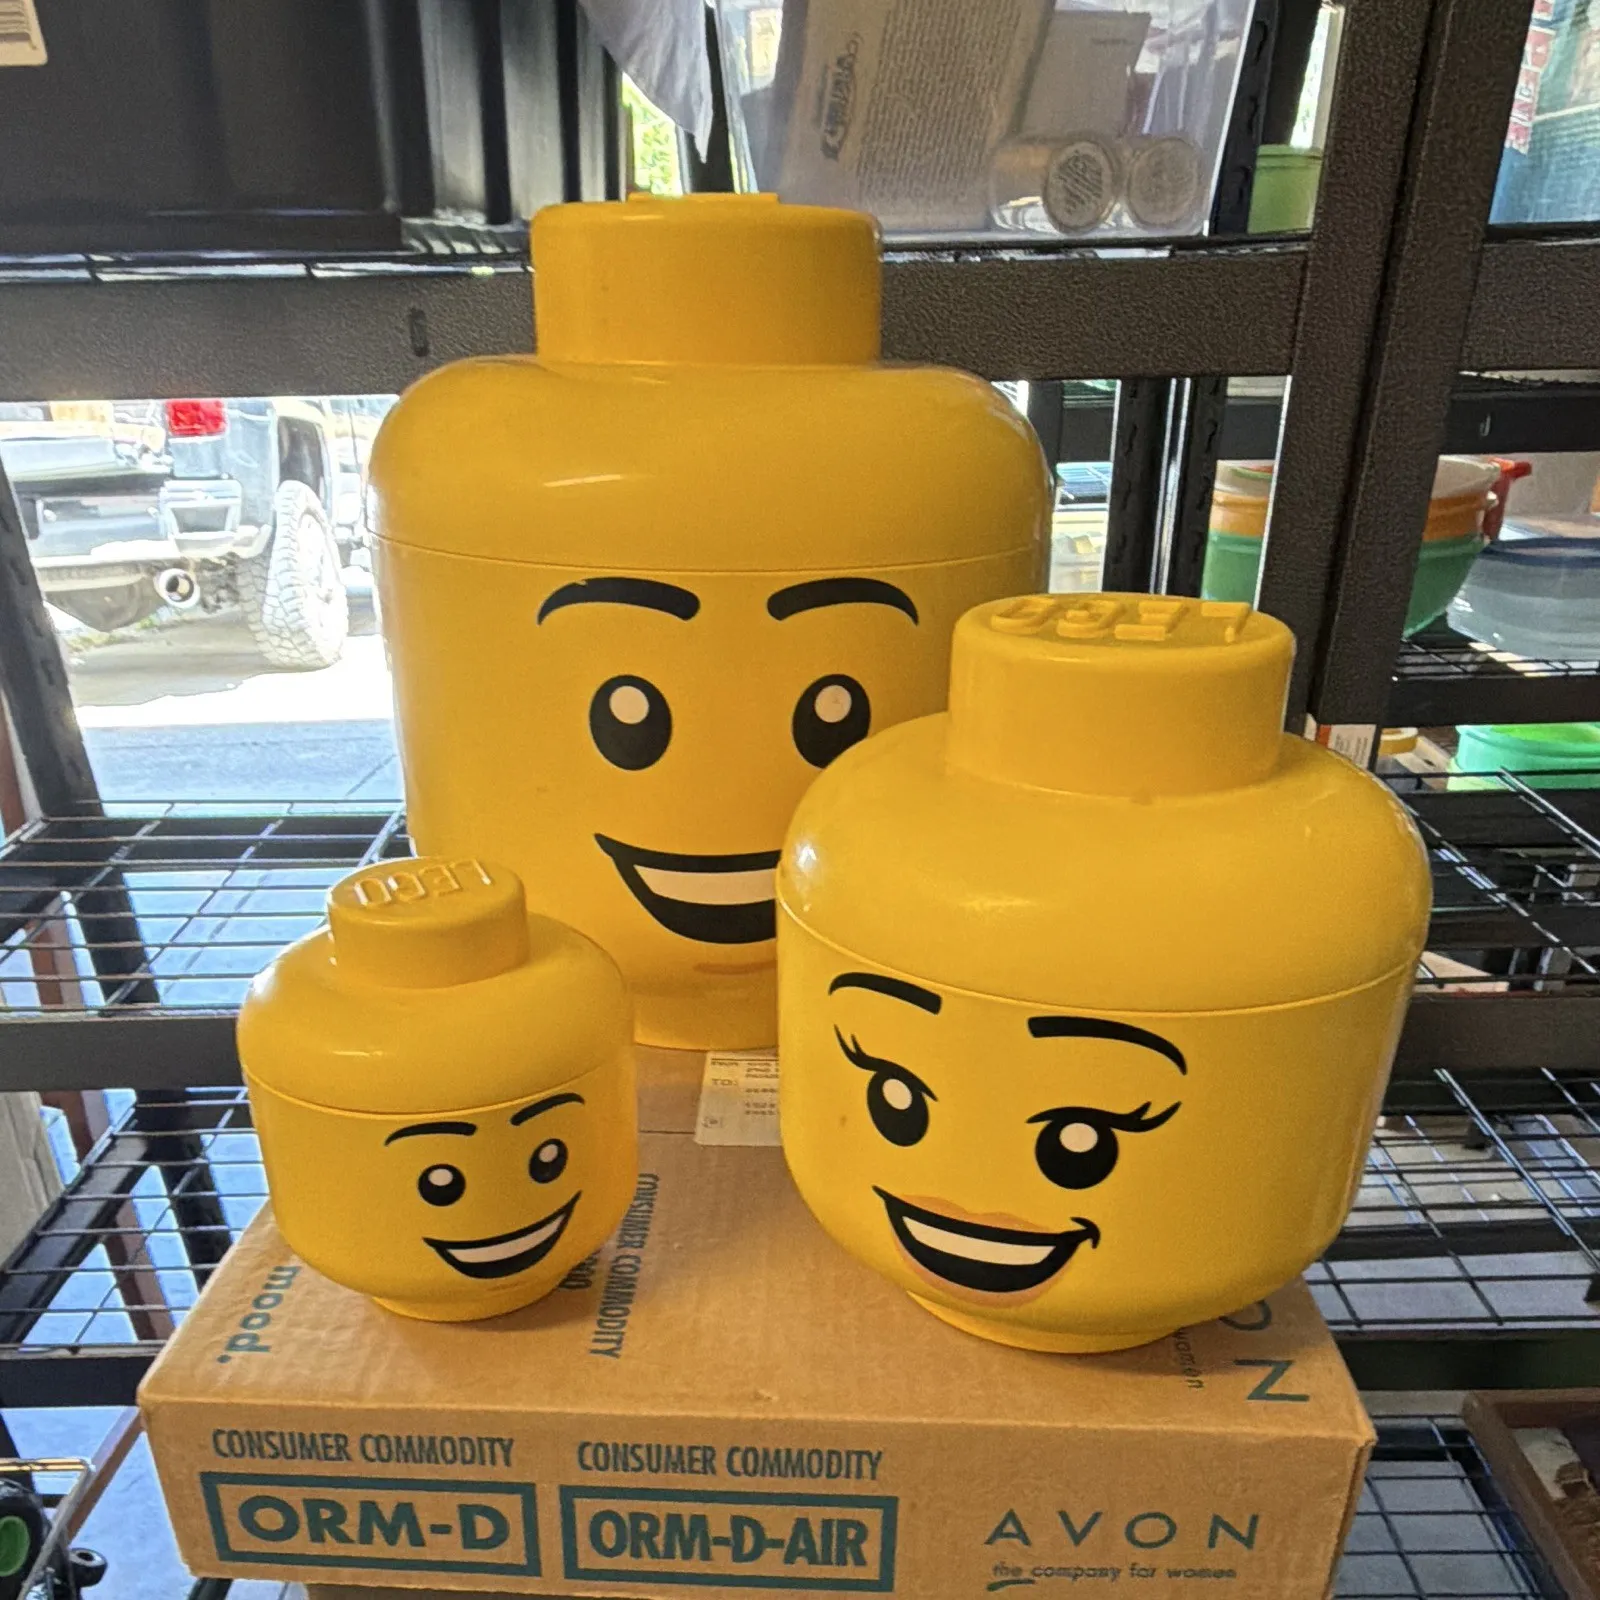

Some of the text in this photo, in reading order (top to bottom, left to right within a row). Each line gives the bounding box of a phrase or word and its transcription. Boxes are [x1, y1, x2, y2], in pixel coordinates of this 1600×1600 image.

[988, 597, 1251, 644] LEGO
[354, 858, 492, 907] LEGO
[589, 1173, 661, 1360] CONSUMER COMMODITY
[216, 1265, 303, 1364] mood.
[211, 1428, 515, 1468] CONSUMER COMMODITY
[576, 1440, 883, 1481] CONSUMER COMMODITY
[237, 1494, 511, 1551] ORM-D
[588, 1509, 869, 1567] ORM-D-AIR
[983, 1507, 1260, 1551] AVON
[992, 1560, 1237, 1583] the company for women
